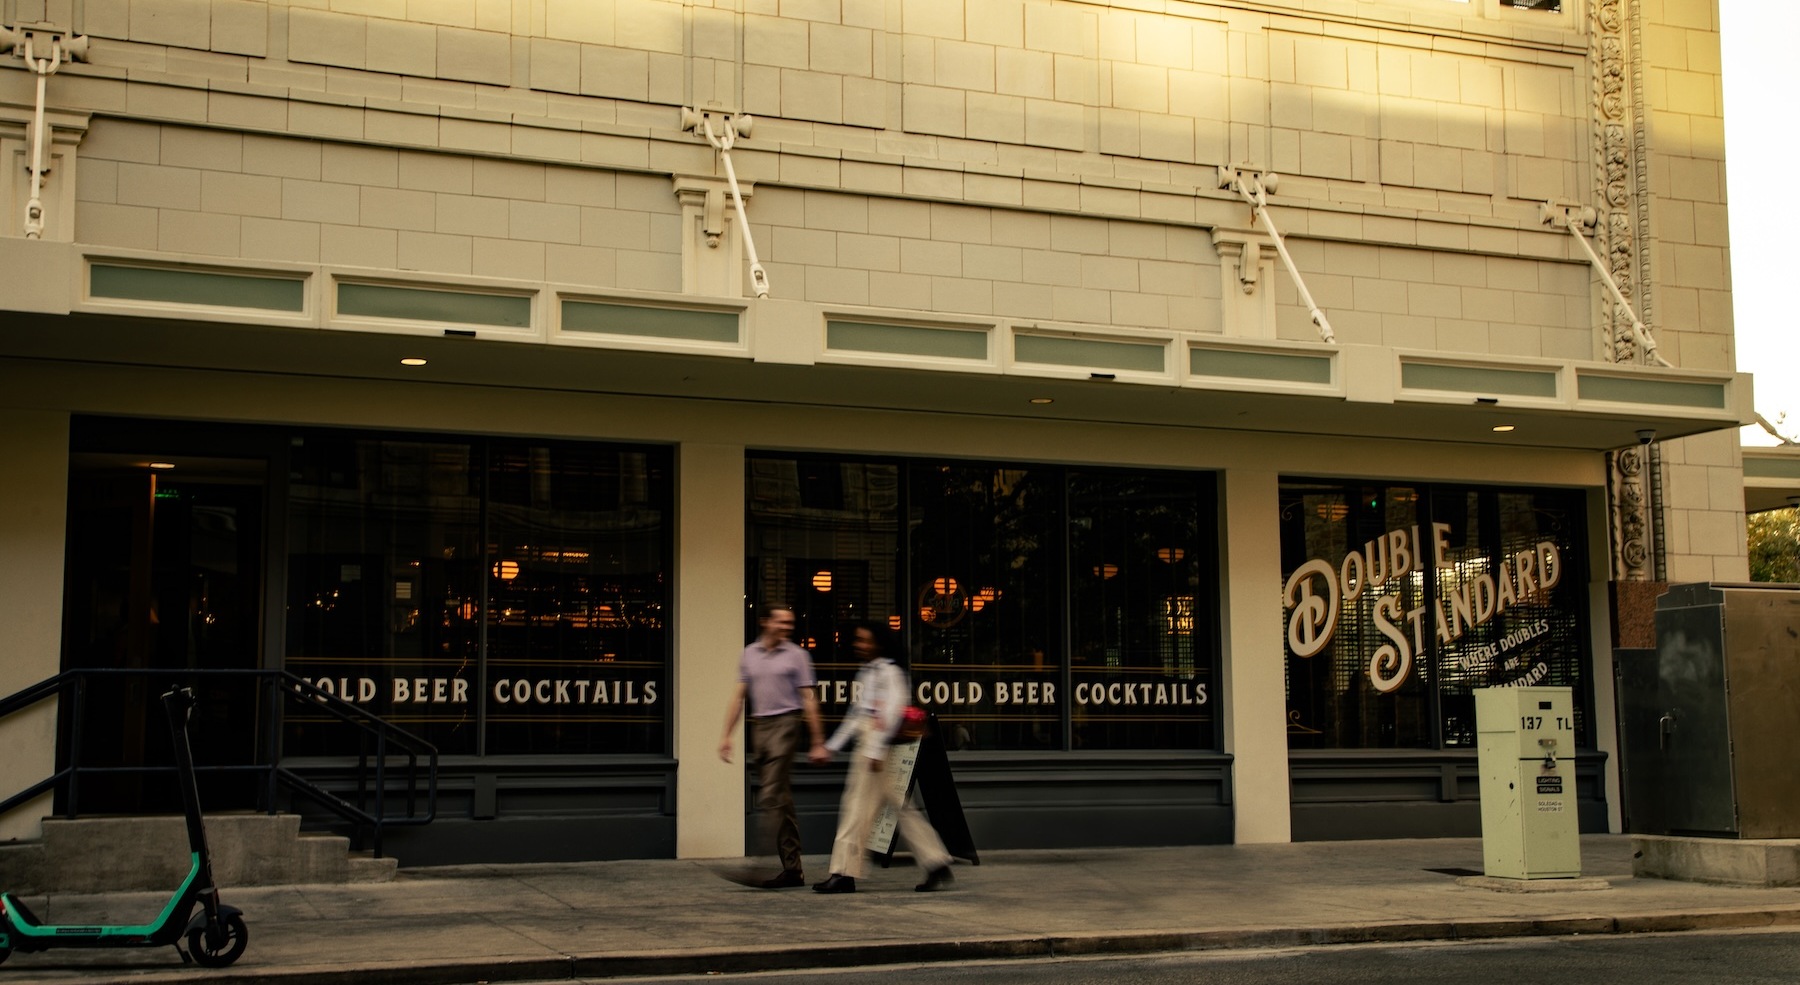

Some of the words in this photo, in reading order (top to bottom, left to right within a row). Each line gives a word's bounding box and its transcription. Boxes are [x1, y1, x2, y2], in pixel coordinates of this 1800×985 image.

[1284, 521, 1454, 658] DOUBLE
[1370, 541, 1562, 693] STANDARD
[1459, 642, 1500, 671] WHERE
[1499, 619, 1549, 652] DOUBLES
[1504, 656, 1520, 672] ARE
[392, 677, 469, 703] BEER
[493, 678, 658, 705] COCKTAILS
[917, 681, 983, 705] COLD
[995, 681, 1056, 705] BEER
[1074, 682, 1208, 706] COCKTAILS
[1521, 716, 1542, 730] 137
[1556, 717, 1573, 731] TL
